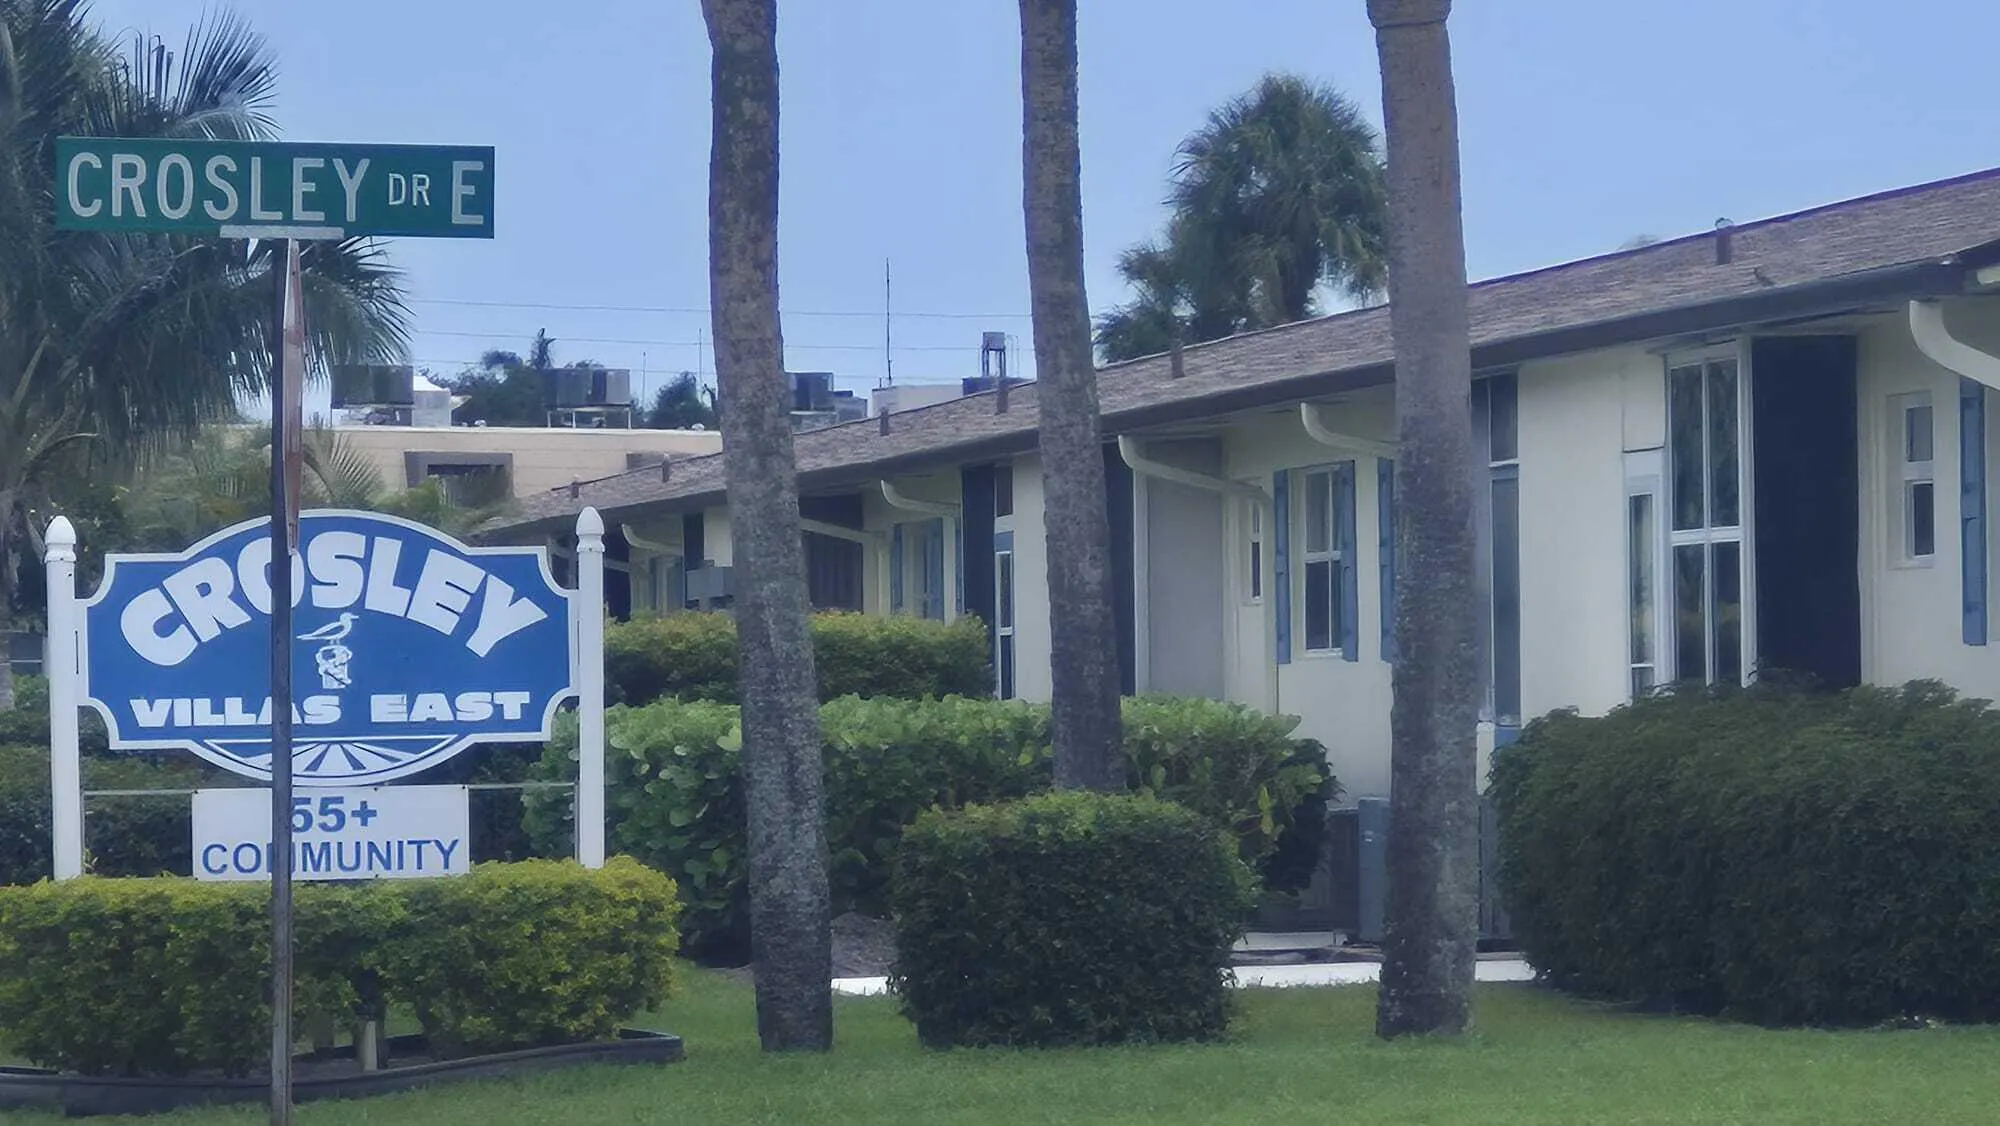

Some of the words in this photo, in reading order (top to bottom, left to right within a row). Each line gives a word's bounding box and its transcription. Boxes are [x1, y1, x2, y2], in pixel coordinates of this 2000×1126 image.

[68, 152, 370, 223] CROSLEY
[388, 173, 431, 206] DR
[451, 160, 485, 225] E
[120, 531, 547, 666] CROSLEY
[370, 692, 530, 723] EAST
[288, 796, 378, 833] 55+
